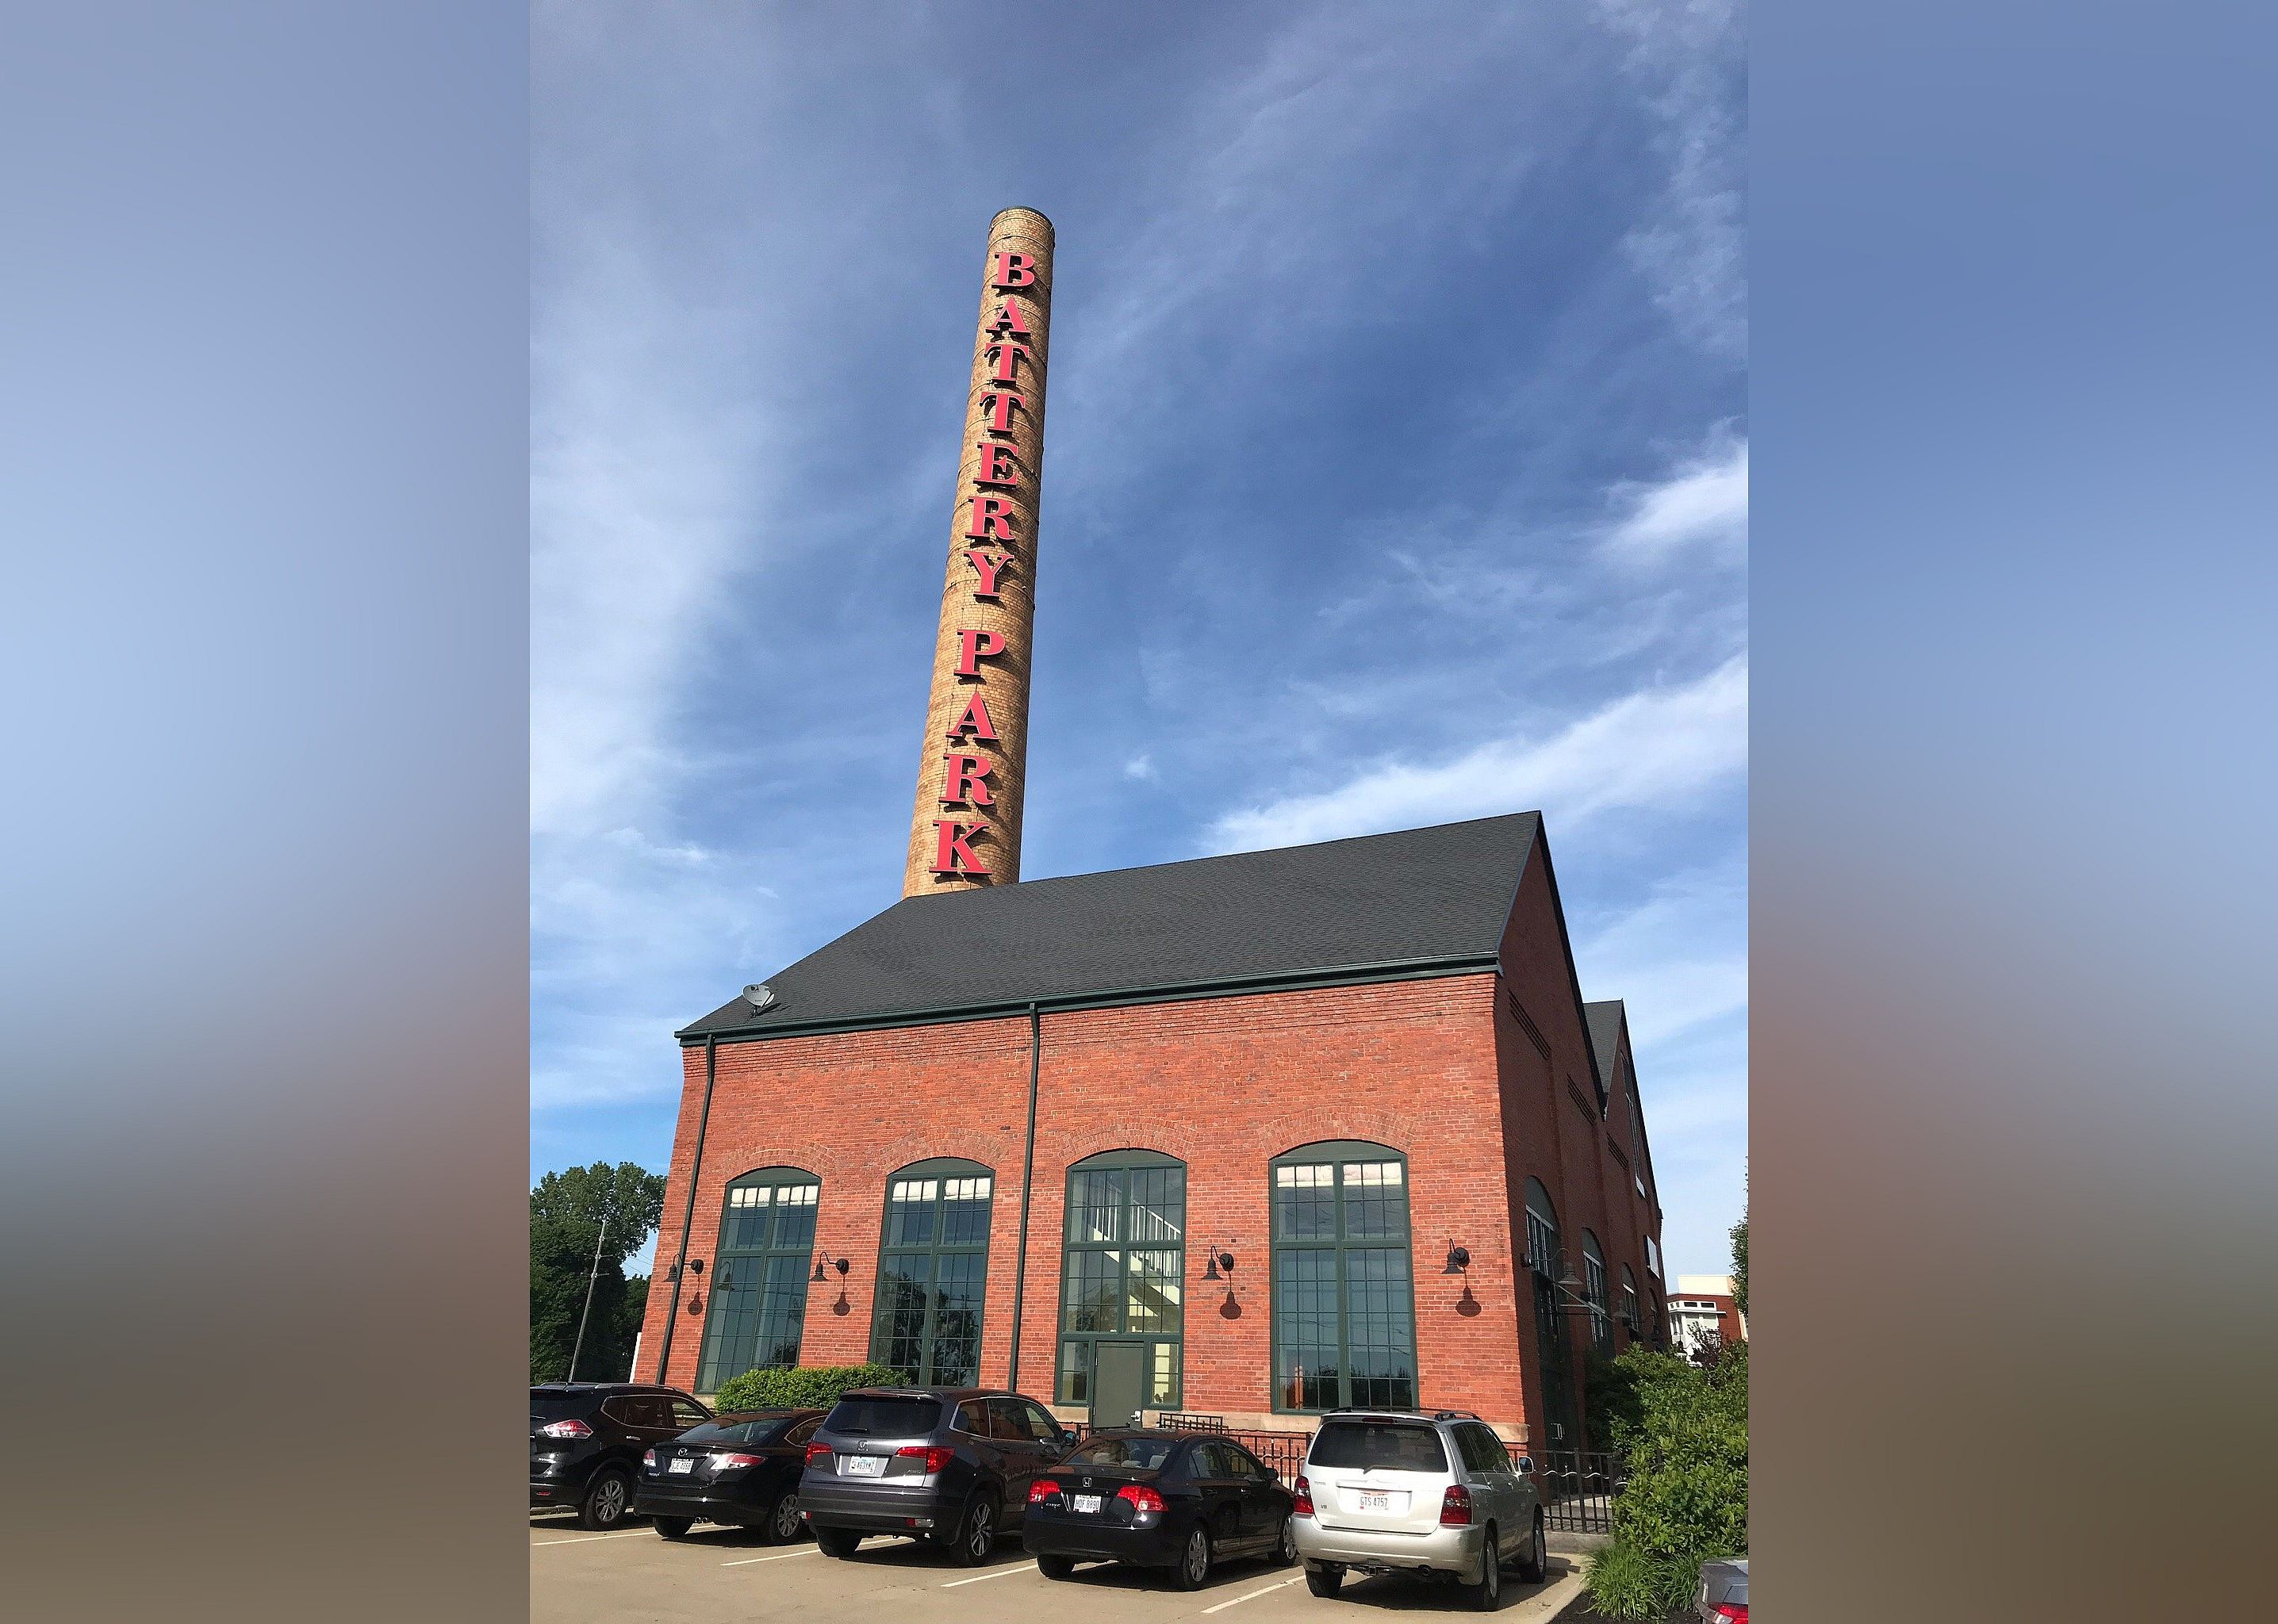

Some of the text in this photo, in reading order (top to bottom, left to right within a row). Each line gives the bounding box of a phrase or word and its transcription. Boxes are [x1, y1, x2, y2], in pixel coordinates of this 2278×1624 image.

[928, 251, 1035, 876] BATTERY PARK
[1360, 1496, 1388, 1507] GTS 4757
